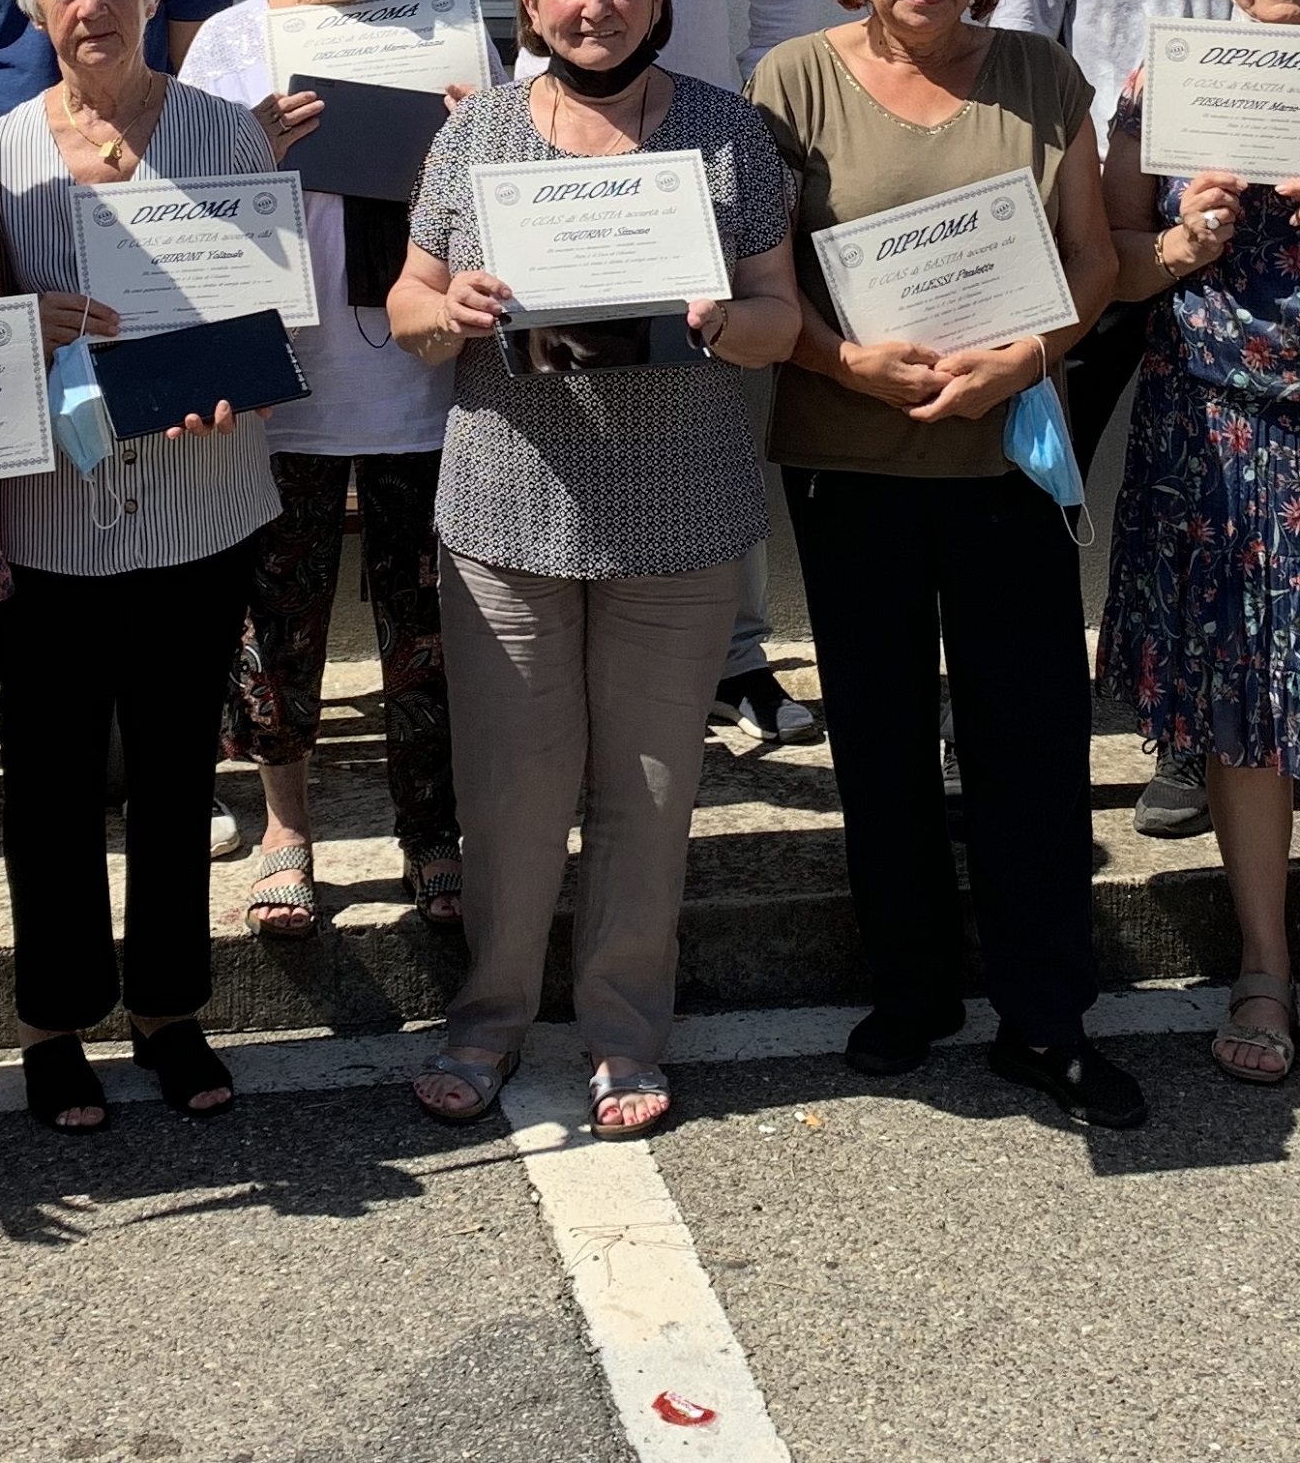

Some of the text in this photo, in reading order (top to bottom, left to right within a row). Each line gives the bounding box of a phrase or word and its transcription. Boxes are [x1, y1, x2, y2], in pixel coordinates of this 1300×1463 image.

[316, 2, 421, 30] DIPLOMA
[1240, 81, 1286, 94] BASTIA
[1191, 96, 1270, 110] PIERANTONI
[532, 177, 643, 205] DIPLOMA
[130, 198, 242, 226] DIPLOMA
[532, 215, 565, 227] CCAS
[578, 210, 623, 223] BASTIA
[176, 232, 219, 245] BASTIA
[876, 210, 979, 262] DIPLOMA
[923, 251, 965, 273] BASTIA
[901, 272, 955, 300] D'ALESSI
